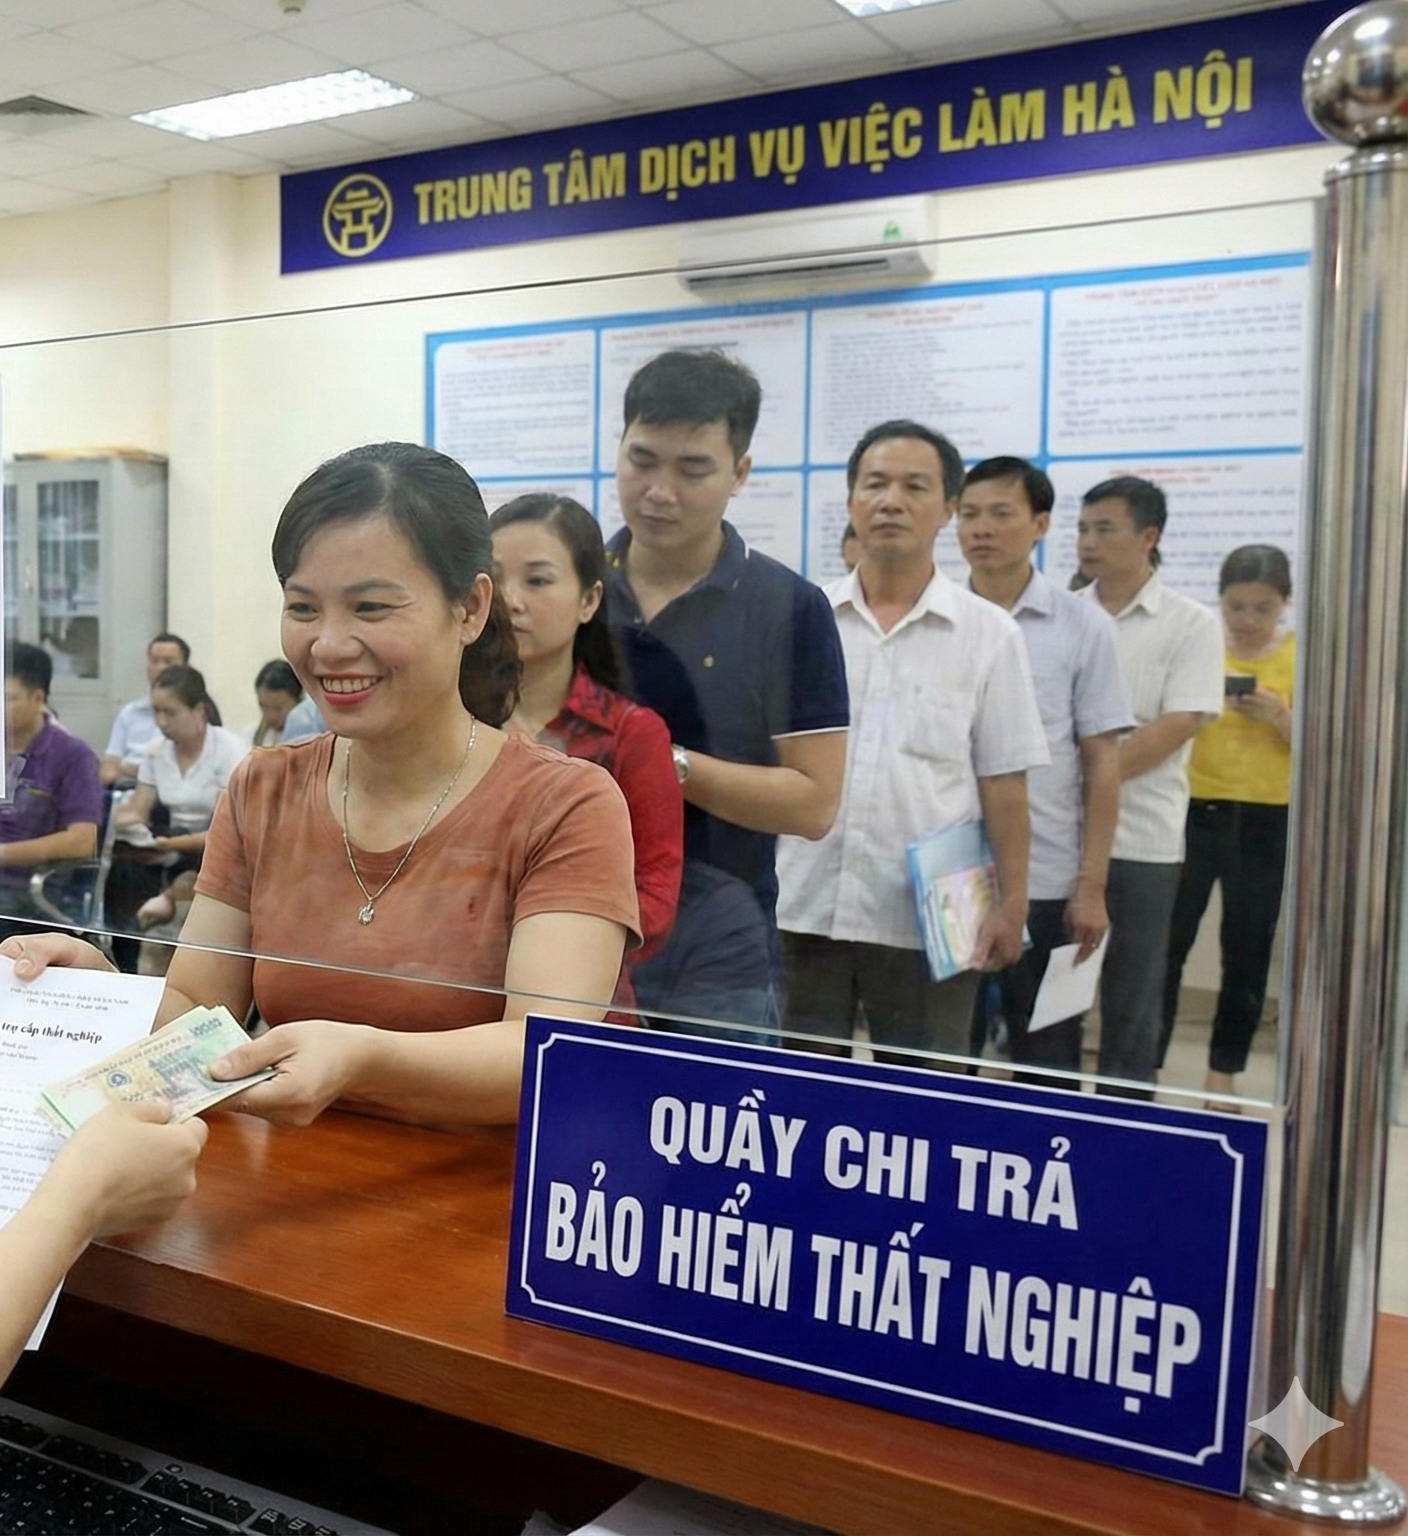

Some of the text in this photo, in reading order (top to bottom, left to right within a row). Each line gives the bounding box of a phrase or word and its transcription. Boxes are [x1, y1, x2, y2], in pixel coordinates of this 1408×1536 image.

[415, 50, 1253, 226] TRUNG TÂM DỊCH VỤ VIỆC LÀM HÀ NỘI
[650, 1089, 1079, 1231] QUẦY CHI TRẢ
[545, 1160, 1201, 1413] BẢO HIỂM THẤT NGHIỆP
